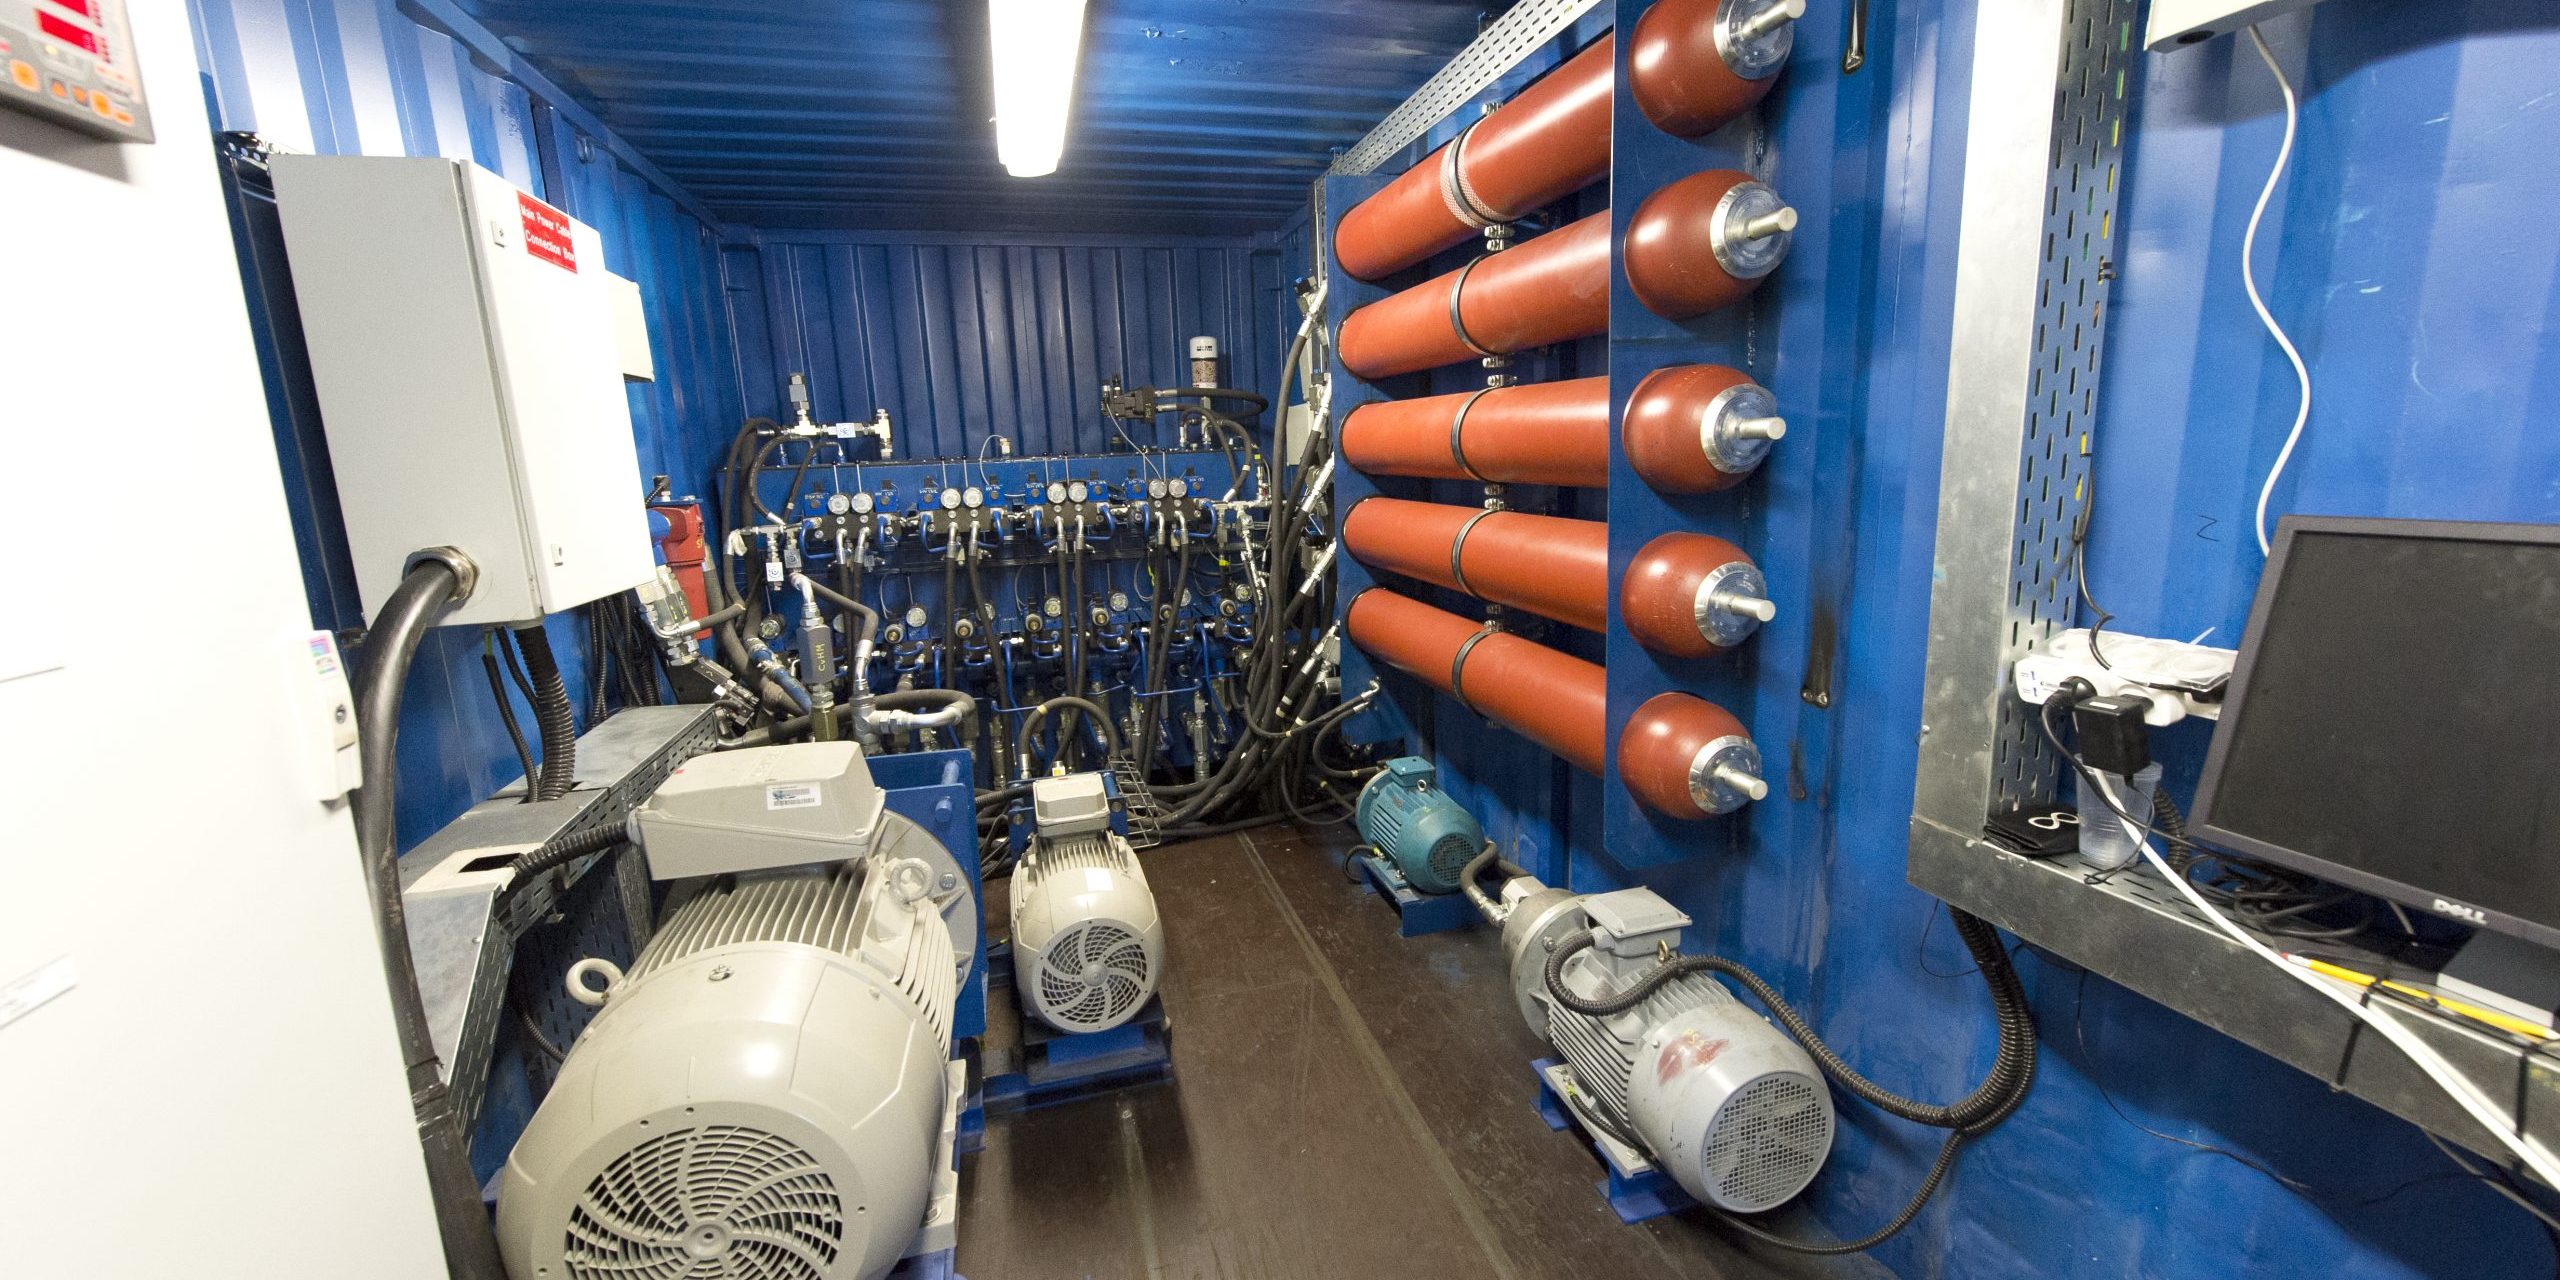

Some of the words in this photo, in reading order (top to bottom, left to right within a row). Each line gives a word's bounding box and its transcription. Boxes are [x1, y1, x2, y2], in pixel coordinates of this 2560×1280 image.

[520, 203, 535, 221] Main
[536, 211, 554, 230] Power
[525, 229, 561, 255] Connection
[2433, 898, 2487, 925] DELL
